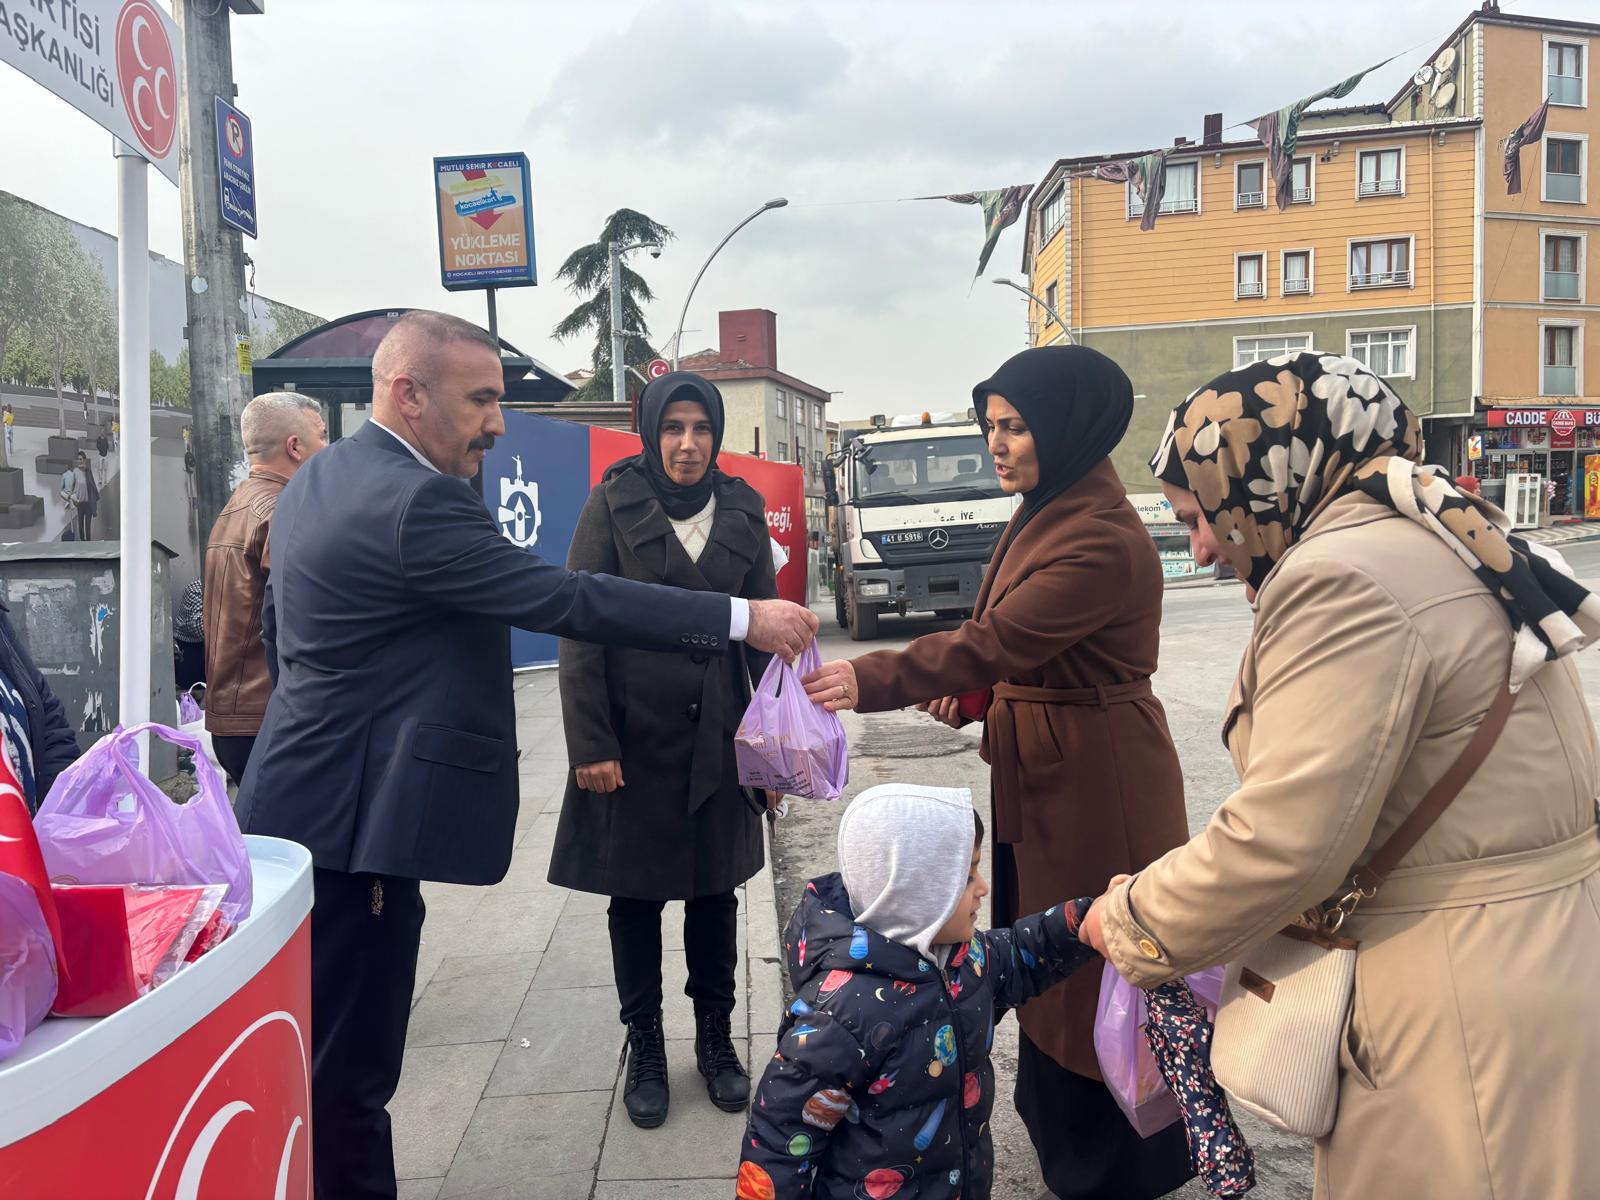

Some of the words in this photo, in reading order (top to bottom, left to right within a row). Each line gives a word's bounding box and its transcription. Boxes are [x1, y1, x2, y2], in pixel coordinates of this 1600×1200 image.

[440, 164, 464, 172] MUTLU
[450, 233, 521, 250] YÜKLEME
[455, 250, 519, 267] NOKTASI
[1506, 411, 1547, 425] CADDE
[765, 506, 792, 533] ceği,
